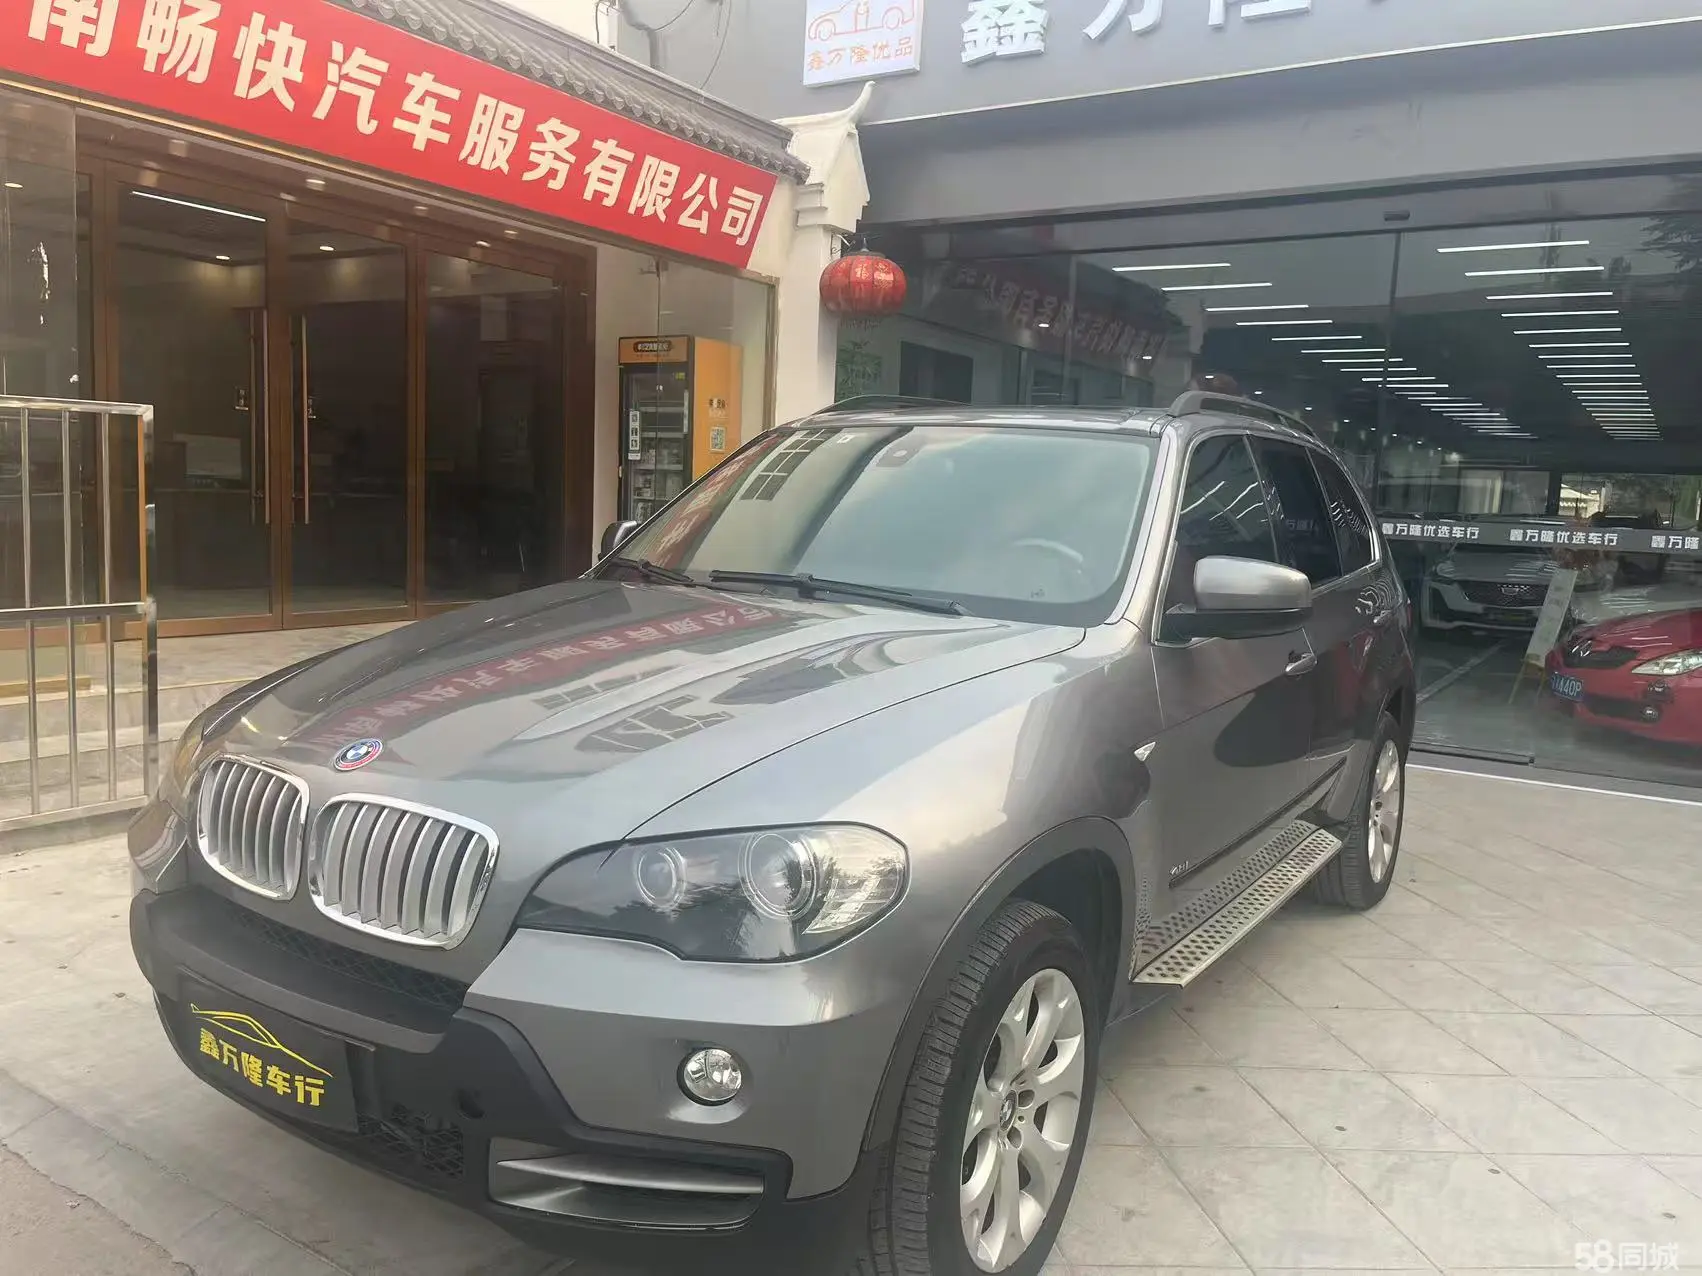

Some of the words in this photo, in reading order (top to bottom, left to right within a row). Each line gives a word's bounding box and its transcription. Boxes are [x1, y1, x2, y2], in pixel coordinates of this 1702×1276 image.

[807, 37, 913, 72] 鑫万隆优品
[199, 1026, 326, 1107] 鑫万隆车行
